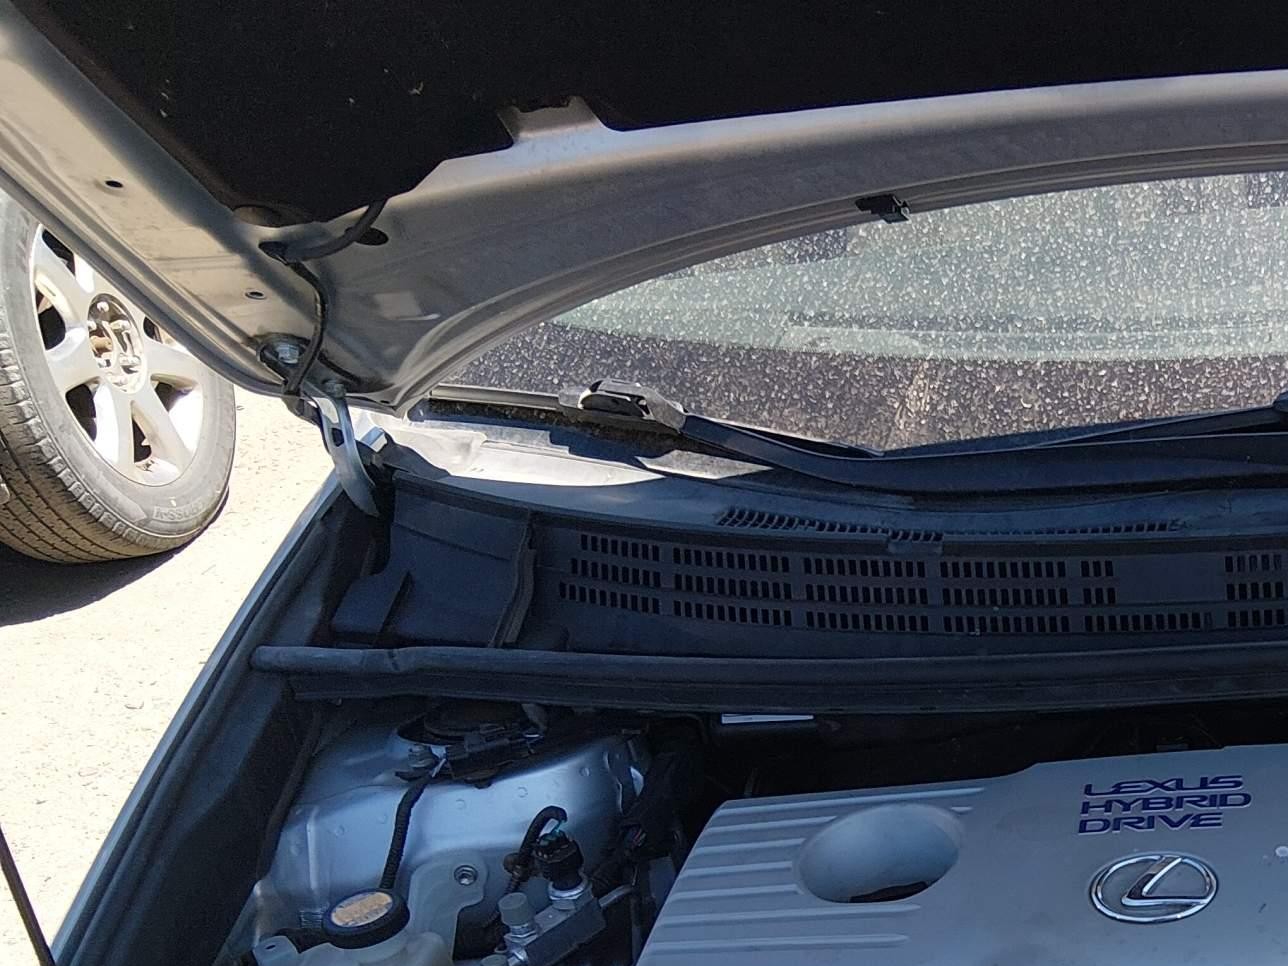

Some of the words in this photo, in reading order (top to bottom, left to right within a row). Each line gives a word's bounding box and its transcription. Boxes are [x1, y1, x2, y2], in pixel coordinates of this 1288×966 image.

[1084, 774, 1244, 797] LEXUS
[1080, 792, 1253, 815] HYBRID
[1077, 812, 1223, 835] DRIVE
